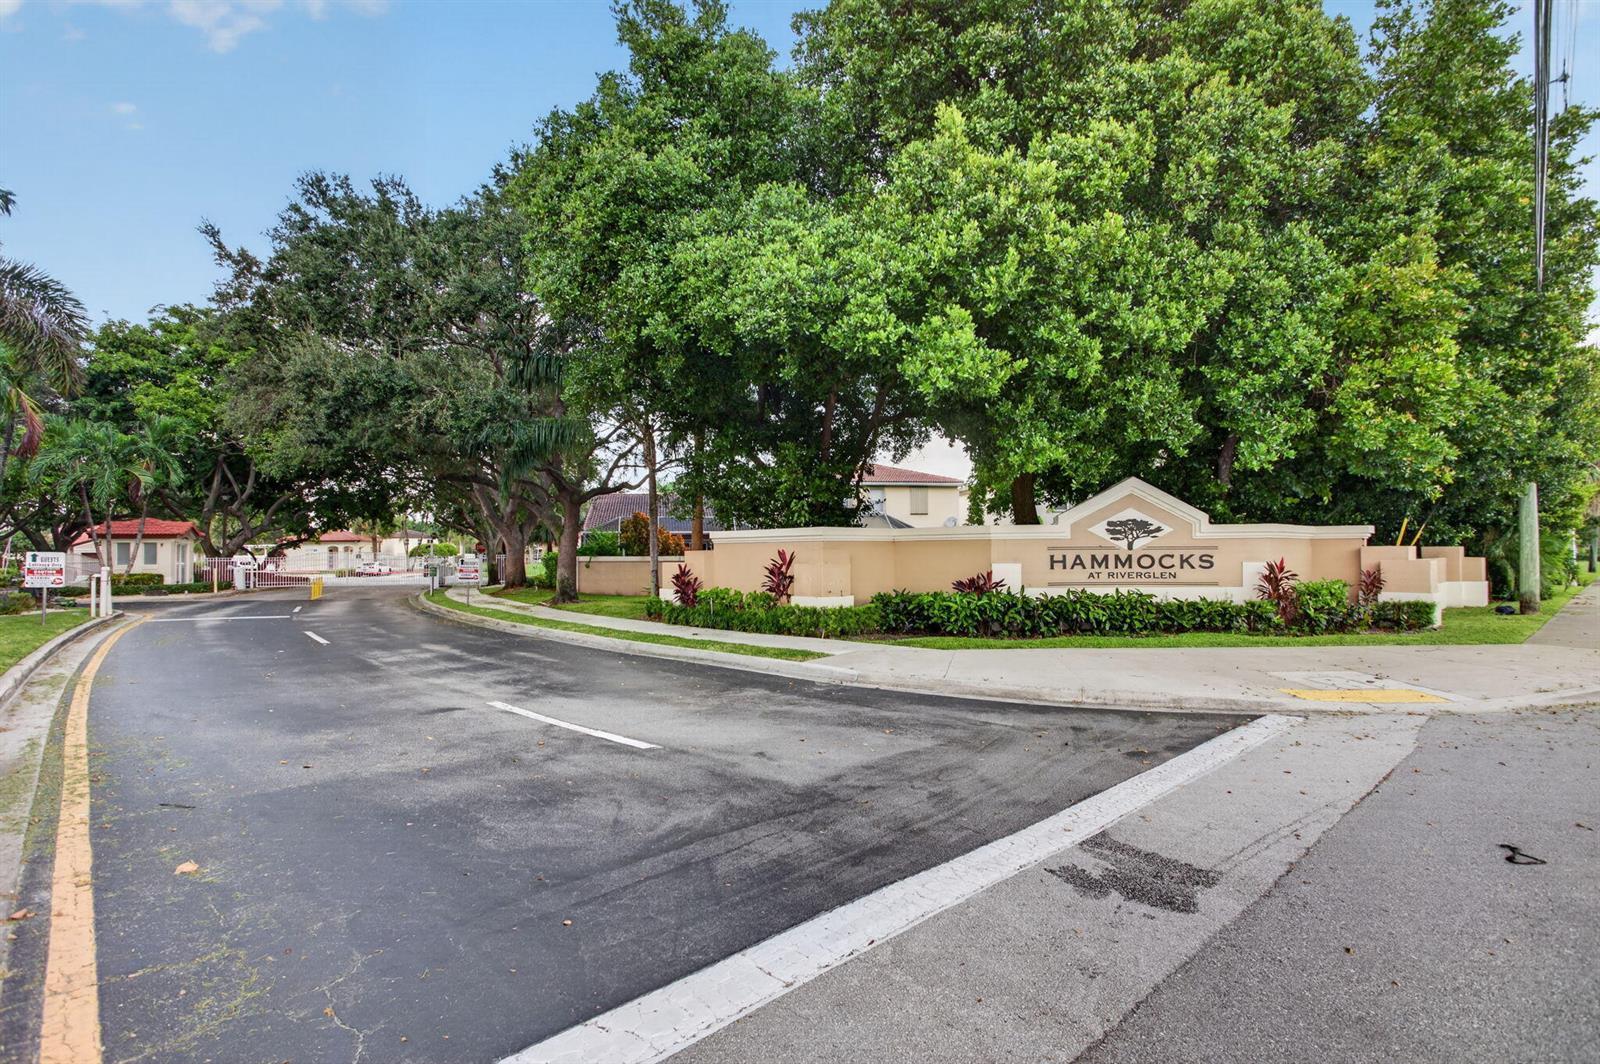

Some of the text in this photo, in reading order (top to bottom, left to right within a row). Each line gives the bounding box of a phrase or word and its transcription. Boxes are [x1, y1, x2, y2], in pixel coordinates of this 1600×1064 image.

[1049, 554, 1215, 570] HAMMOCKS
[1087, 571, 1177, 580] AT RIVERGLEN
